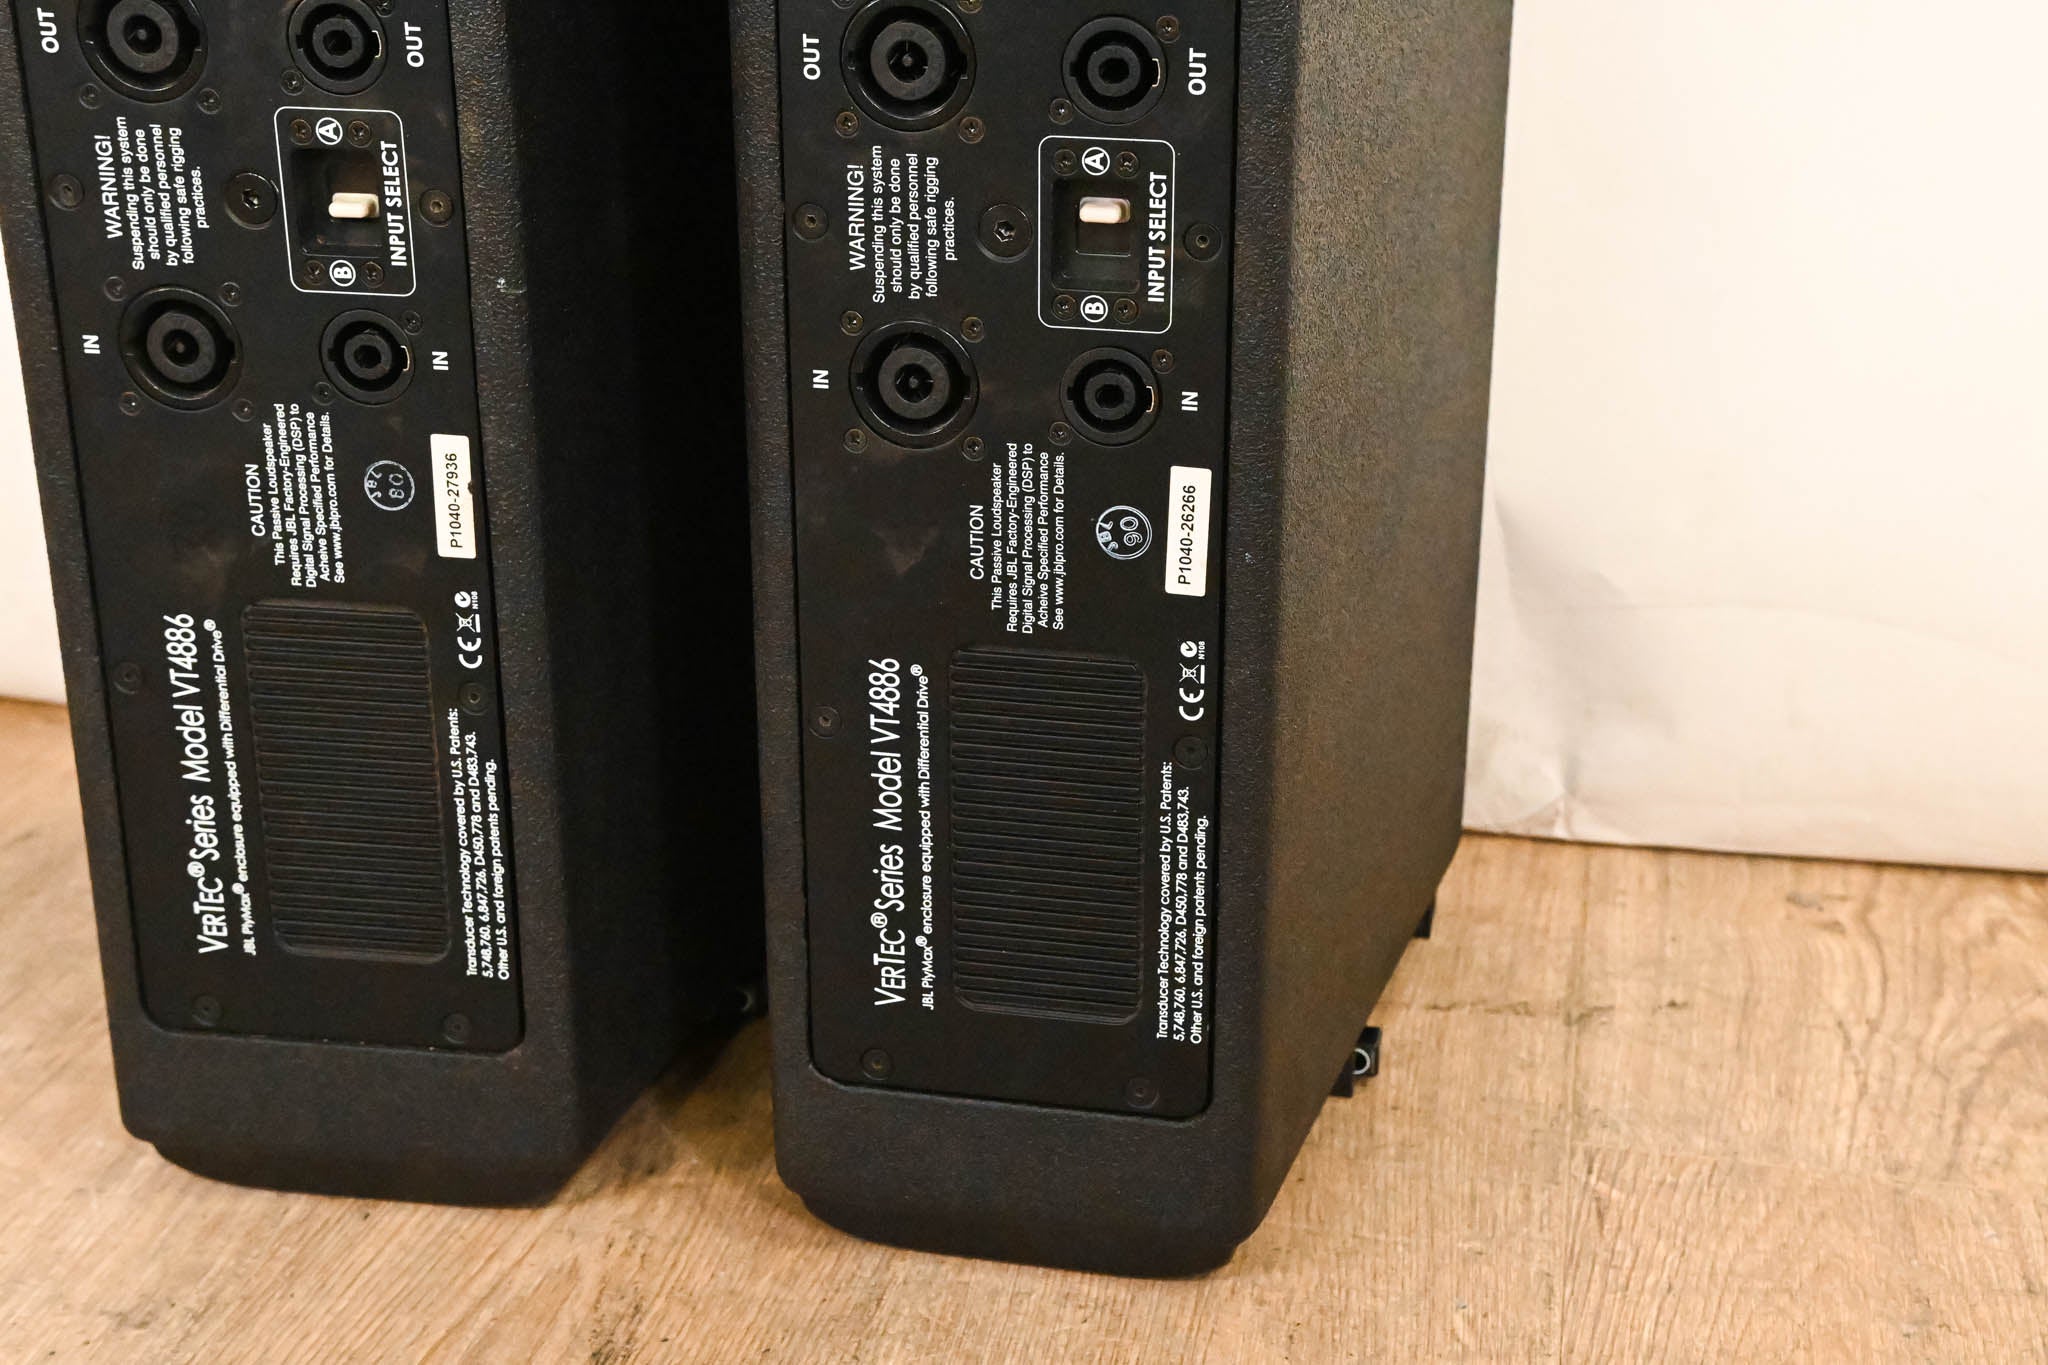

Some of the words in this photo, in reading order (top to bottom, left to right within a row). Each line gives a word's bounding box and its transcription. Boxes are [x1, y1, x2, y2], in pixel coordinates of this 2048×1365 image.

[36, 7, 60, 54] OUT
[403, 21, 425, 68] OUT
[802, 33, 821, 81] OUT
[1187, 47, 1207, 96] OUT
[116, 116, 134, 164] system
[135, 129, 149, 163] done
[148, 123, 172, 190] personnel
[168, 127, 186, 172] rigging
[94, 135, 123, 239] WARNING!
[121, 167, 135, 191] this
[138, 165, 151, 183] be
[172, 175, 188, 204] safe
[380, 140, 403, 208] SELECT
[870, 145, 886, 194] system
[888, 158, 901, 193] done
[905, 153, 922, 221] personnel
[923, 156, 940, 203] rigging
[140, 185, 156, 214] only
[157, 192, 178, 247] qualified
[190, 166, 210, 229] practices.
[846, 164, 866, 271] WARNING!
[871, 197, 884, 222] this
[888, 196, 901, 214] be
[924, 206, 937, 236] safe
[1148, 171, 1167, 242] SELECT
[125, 193, 145, 270] Suspending
[143, 216, 161, 260] should
[177, 207, 195, 265] following
[386, 212, 408, 267] INPUT
[889, 216, 905, 245] only
[906, 223, 923, 280] qualified
[942, 197, 958, 261] practices.
[165, 249, 180, 266] by
[871, 224, 888, 304] Suspending
[889, 248, 903, 293] should
[925, 239, 940, 298] following
[1147, 246, 1166, 303] INPUT
[907, 283, 923, 300] by
[82, 334, 101, 355] IN
[431, 351, 449, 371] IN
[812, 369, 830, 389] IN
[1181, 391, 1199, 412] IN
[289, 403, 300, 415] to
[319, 411, 333, 453] Details.
[273, 403, 295, 512] Factory-Engineered
[289, 417, 306, 452] (DSP)
[305, 411, 321, 483] Performance
[1022, 443, 1033, 455] to
[262, 422, 279, 495] Loudspeaker
[323, 455, 335, 471] for
[1021, 457, 1036, 493] (DSP)
[1053, 452, 1065, 495] Details.
[244, 463, 266, 537] CAUTION
[294, 454, 310, 515] Processing
[366, 470, 385, 500] JBL
[442, 452, 465, 549] P1040-27936
[990, 462, 1004, 537] Loudspeaker
[1006, 442, 1020, 555] Factory-Engineered
[1037, 451, 1049, 525] Performance
[1053, 497, 1065, 513] for
[269, 497, 283, 540] Passive
[285, 513, 298, 536] JBL
[311, 485, 328, 536] Specified
[326, 473, 343, 559] www.jblpro.com
[1021, 495, 1036, 558] Processing
[273, 542, 286, 566] This
[299, 517, 315, 552] Signal
[969, 504, 985, 580] CAUTION
[1037, 528, 1051, 581] Specified
[1177, 484, 1196, 586] P1040-26266
[288, 537, 303, 587] Requires
[303, 553, 319, 588] Digital
[317, 537, 331, 582] Acheive
[333, 561, 346, 584] See
[991, 539, 1002, 584] Passive
[1006, 557, 1018, 580] JBL
[1021, 561, 1036, 597] Signal
[1053, 516, 1067, 605] www.jblpro.com
[991, 586, 1003, 611] This
[1006, 582, 1020, 632] Requires
[1021, 599, 1036, 634] Digital
[1037, 583, 1049, 628] Acheive
[1052, 607, 1064, 631] See
[163, 613, 201, 698] VT4886
[213, 664, 233, 732] Differential
[868, 658, 901, 744] VT4886
[172, 704, 212, 783] Model
[221, 732, 235, 759] with
[447, 708, 461, 755] Patents:
[916, 711, 930, 780] Differential
[223, 760, 243, 822] equipped
[450, 757, 463, 778] U.S.
[452, 779, 466, 796] by
[484, 758, 500, 811] pending.
[870, 751, 903, 831] Model
[1159, 761, 1173, 810] Patents:
[468, 788, 482, 813] and
[917, 781, 931, 808] with
[1176, 786, 1190, 843] D483,743.
[185, 794, 221, 861] Series
[453, 797, 468, 847] covered
[487, 813, 504, 857] patents
[918, 810, 934, 873] equipped
[1159, 812, 1172, 834] U.S.
[1159, 836, 1174, 852] by
[1194, 815, 1209, 869] pending.
[232, 823, 249, 882] enclosure
[1176, 845, 1188, 871] and
[458, 847, 473, 914] Technology
[491, 858, 505, 898] foreign
[872, 843, 905, 912] Series
[1159, 854, 1171, 905] covered
[1174, 872, 1188, 926] D450,778
[1193, 871, 1207, 917] patents
[493, 899, 506, 924] and
[920, 875, 933, 935] enclosure
[243, 936, 257, 956] JBL
[464, 914, 478, 976] Transducer
[495, 925, 508, 946] U.S.
[1157, 906, 1173, 975] Technology
[1174, 928, 1188, 984] 6,847,726,
[1191, 918, 1207, 960] foreign
[497, 946, 510, 980] Other
[1191, 961, 1204, 986] and
[921, 990, 934, 1011] JBL
[1156, 976, 1169, 1039] Transducer
[1173, 986, 1187, 1042] 5,748,760,
[1191, 988, 1203, 1009] U.S.
[1189, 1010, 1203, 1044] Other
